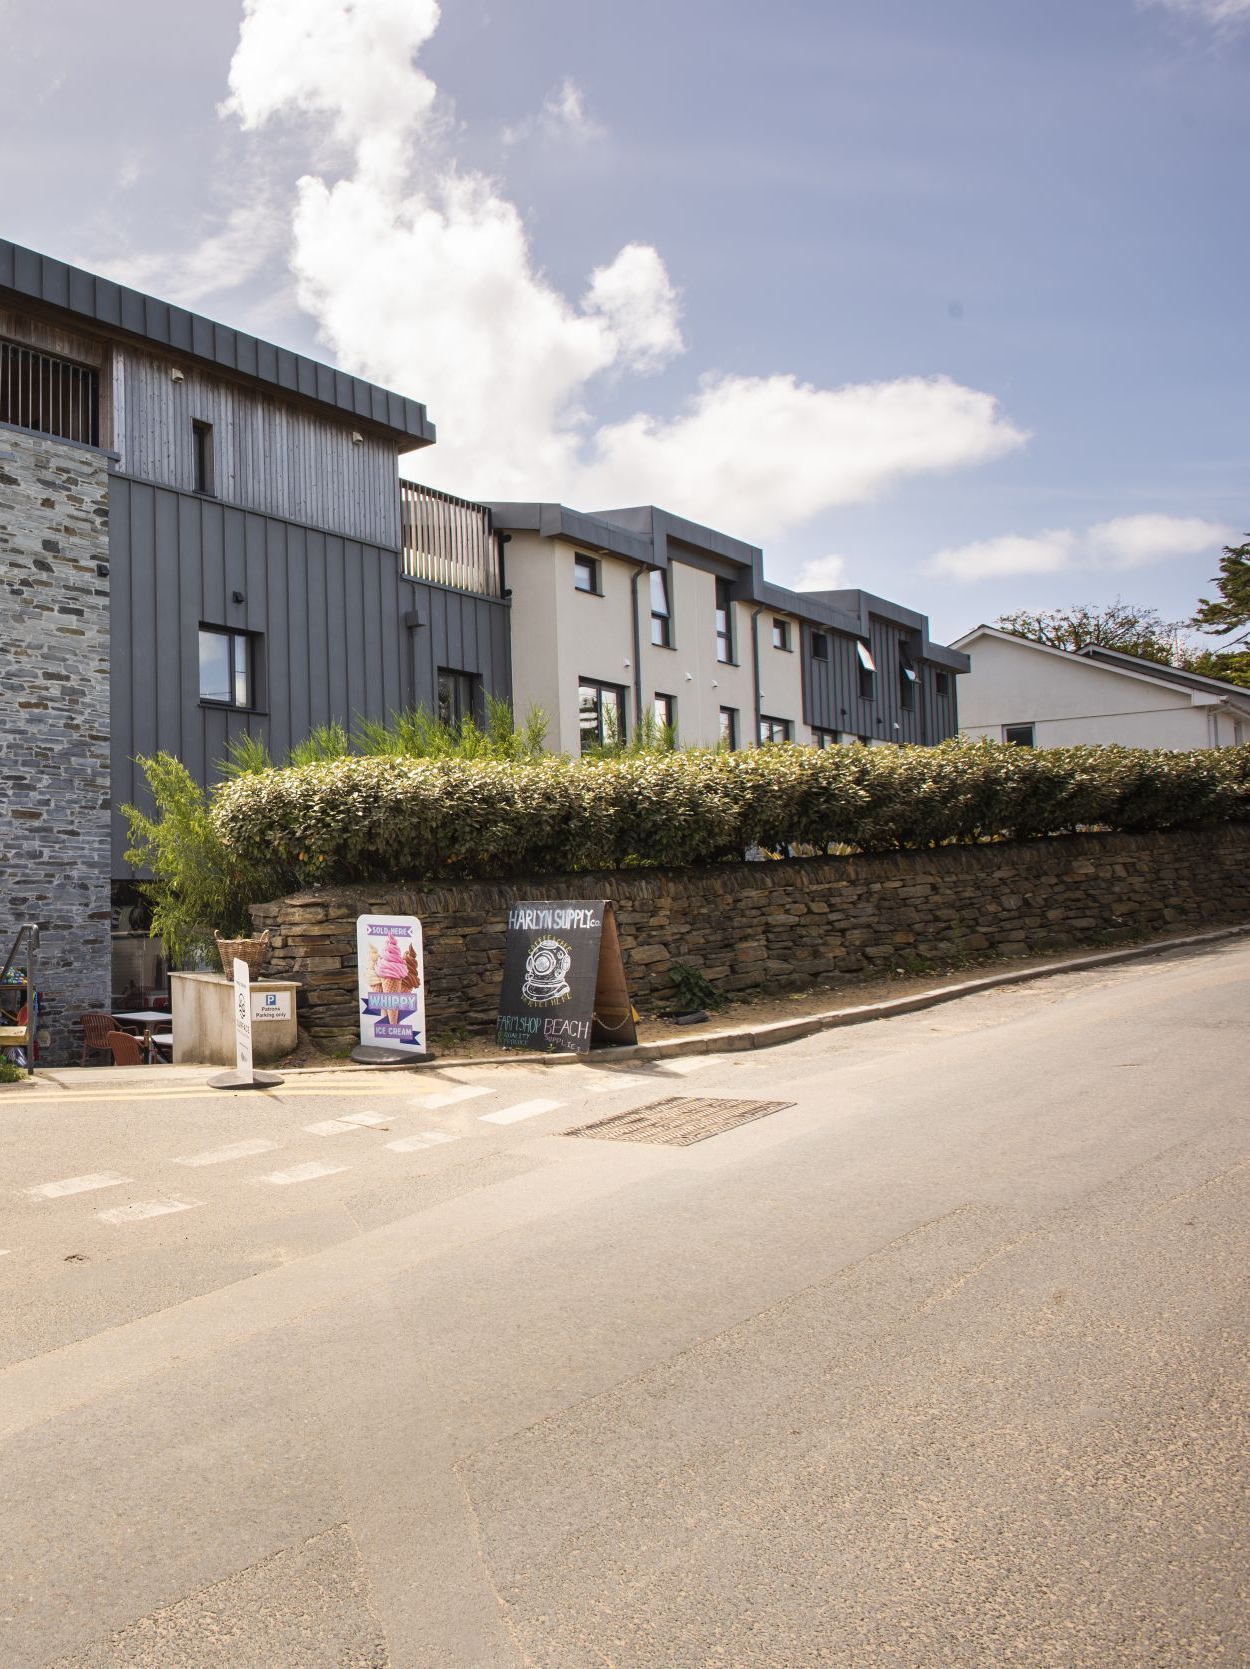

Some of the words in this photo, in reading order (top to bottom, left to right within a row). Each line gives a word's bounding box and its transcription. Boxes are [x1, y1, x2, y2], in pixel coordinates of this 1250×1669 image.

[509, 909, 552, 929] HARLYN
[554, 908, 594, 929] SUPPLY
[372, 926, 389, 935] SOLD
[390, 927, 407, 935] HERE
[267, 995, 275, 1005] P
[369, 994, 416, 1009] WHIPPY
[376, 1026, 387, 1034] ICE
[388, 1027, 412, 1036] CREAM
[543, 1018, 589, 1040] BEACH
